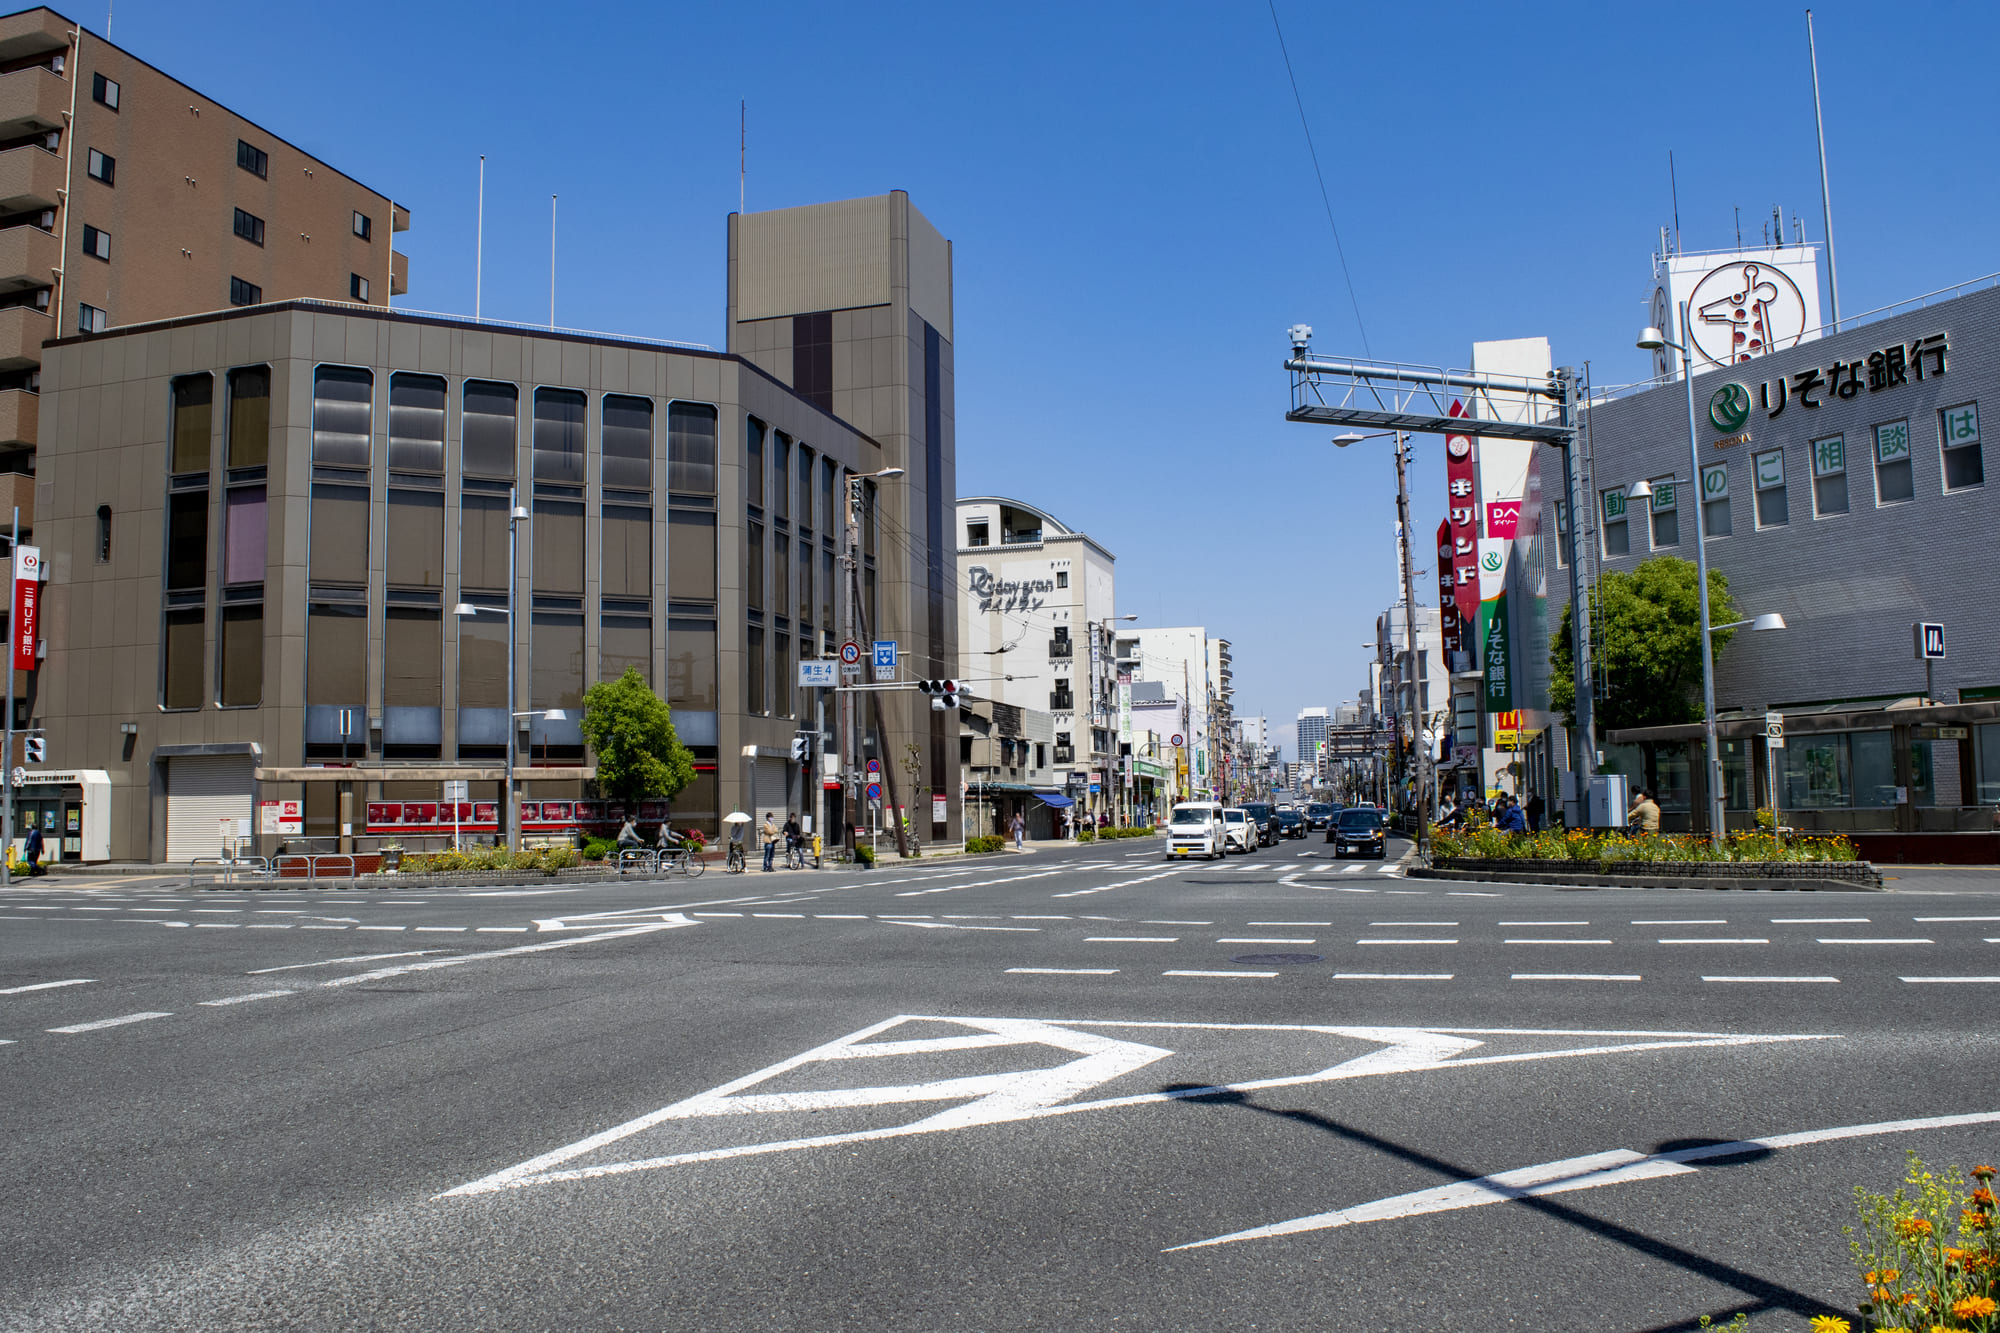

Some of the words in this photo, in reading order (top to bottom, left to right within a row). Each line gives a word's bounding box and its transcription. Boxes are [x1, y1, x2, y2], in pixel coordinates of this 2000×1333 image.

[1761, 332, 1949, 419] りそな銀行
[1713, 432, 1752, 449] RESONA
[1450, 478, 1476, 586] キリンド
[22, 587, 35, 656] 三菱UFJ銀行
[1022, 579, 1054, 598] gran
[1488, 618, 1507, 698] りそな銀行
